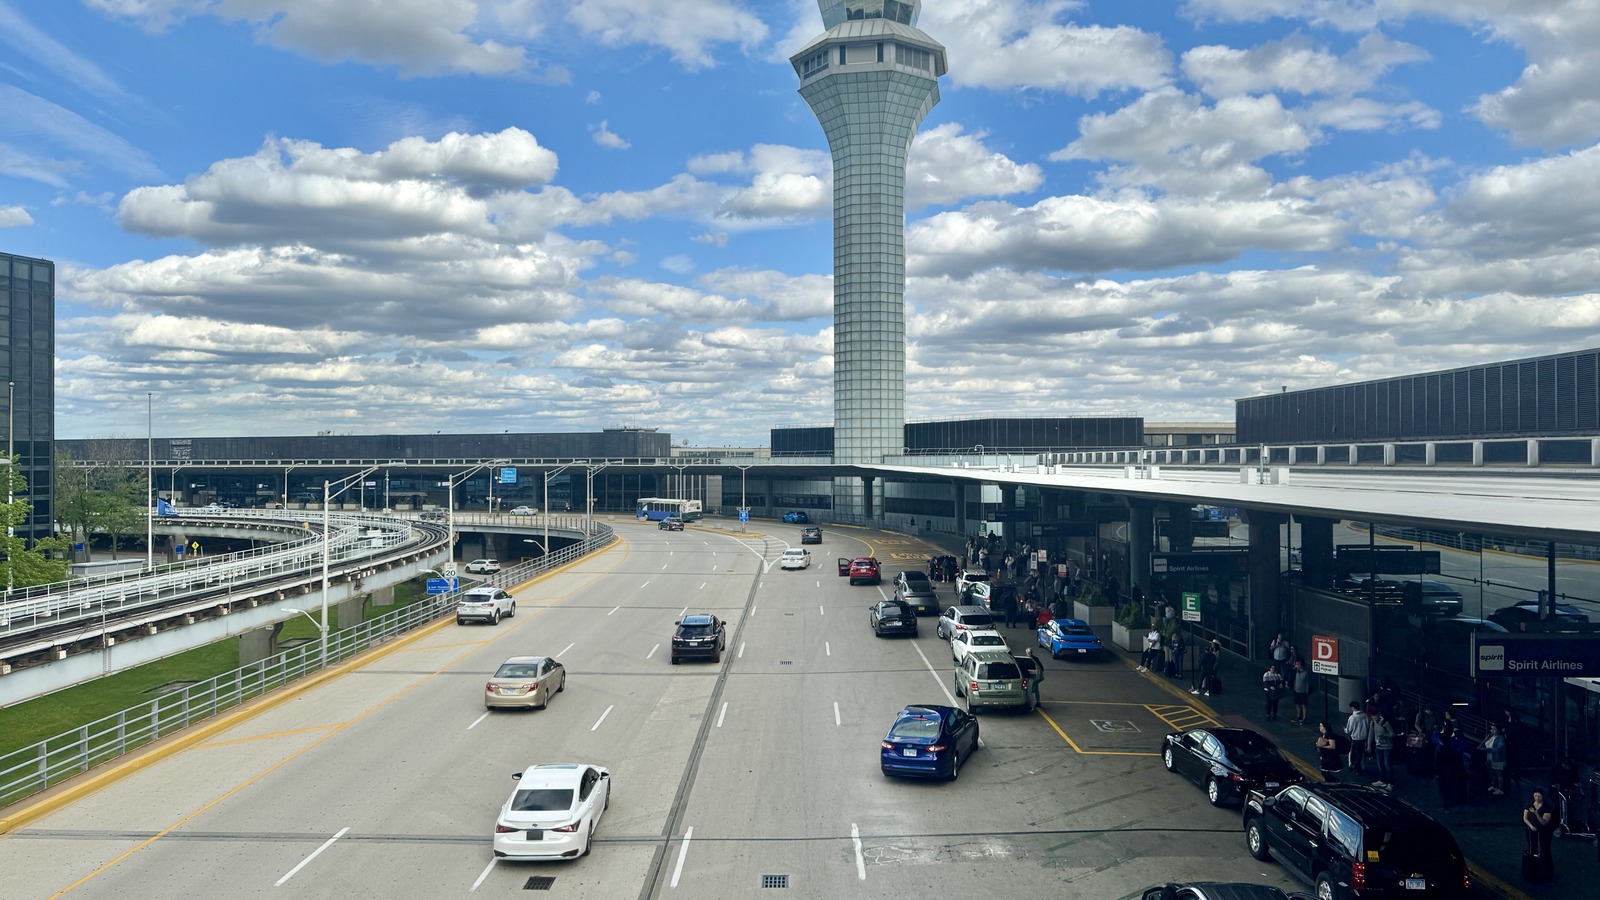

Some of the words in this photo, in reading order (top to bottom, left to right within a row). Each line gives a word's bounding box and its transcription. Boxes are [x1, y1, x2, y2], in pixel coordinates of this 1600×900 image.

[1186, 597, 1196, 610] E
[1317, 642, 1333, 659] D
[1480, 653, 1504, 662] spirit
[1508, 660, 1539, 671] Spirit
[1541, 660, 1583, 670] Airlines
